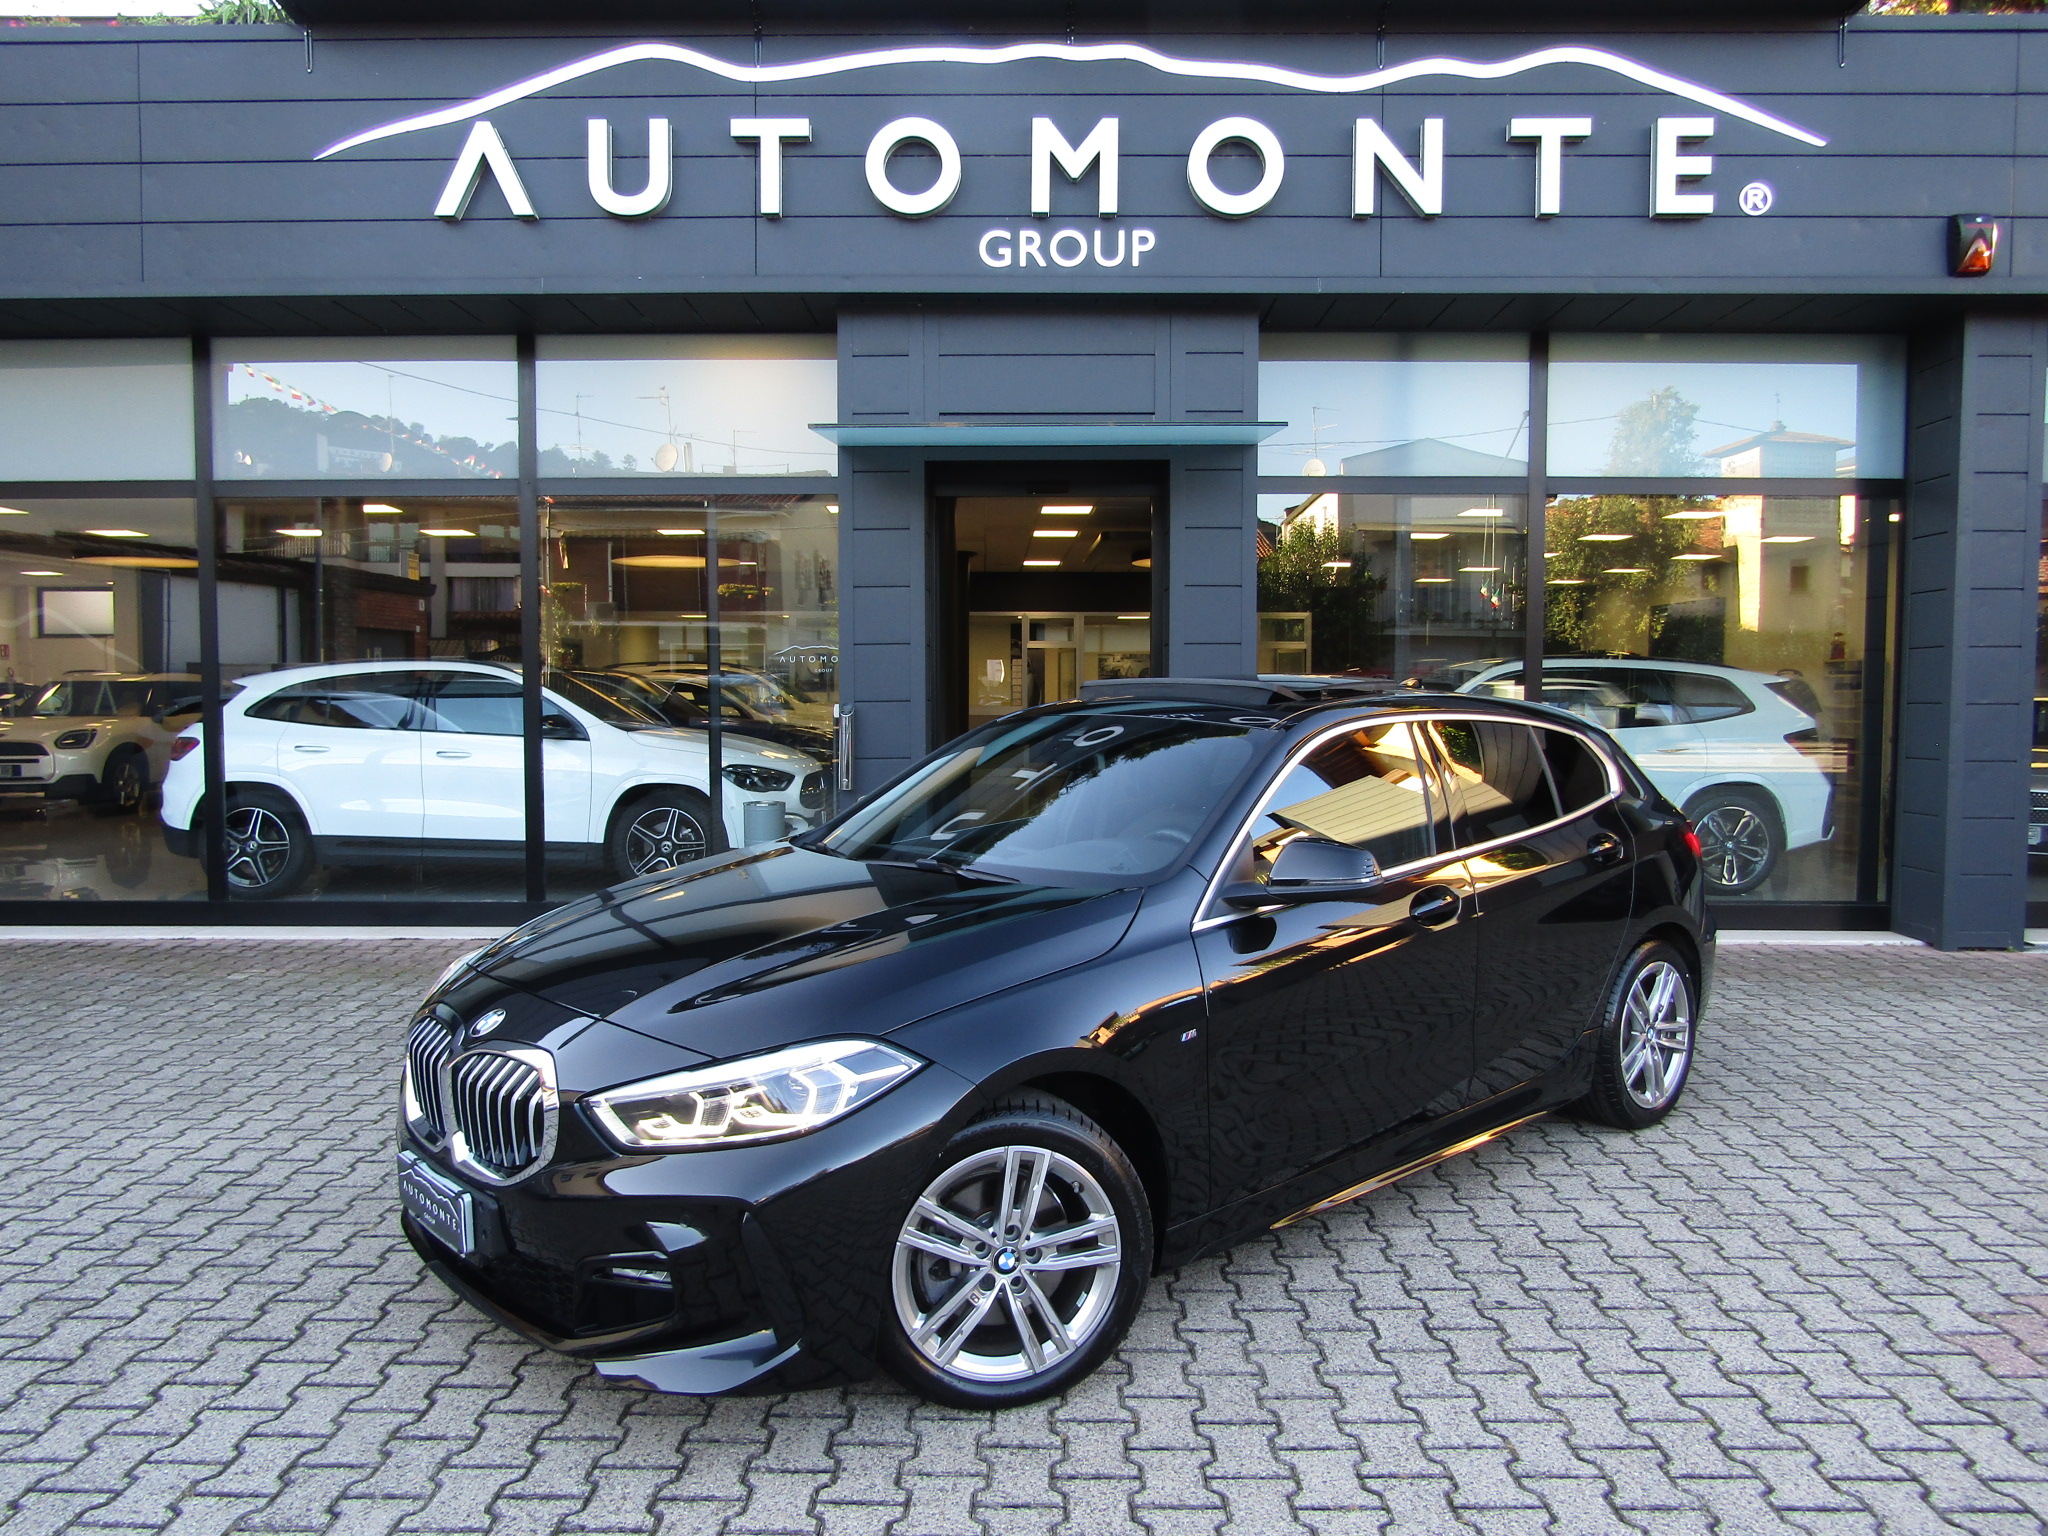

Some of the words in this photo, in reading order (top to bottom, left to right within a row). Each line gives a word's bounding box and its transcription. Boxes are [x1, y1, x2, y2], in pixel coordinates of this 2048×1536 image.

[434, 117, 1715, 216] AUTOMONTE
[978, 229, 1157, 268] GROUP
[402, 1180, 457, 1231] AUTOMONTE
